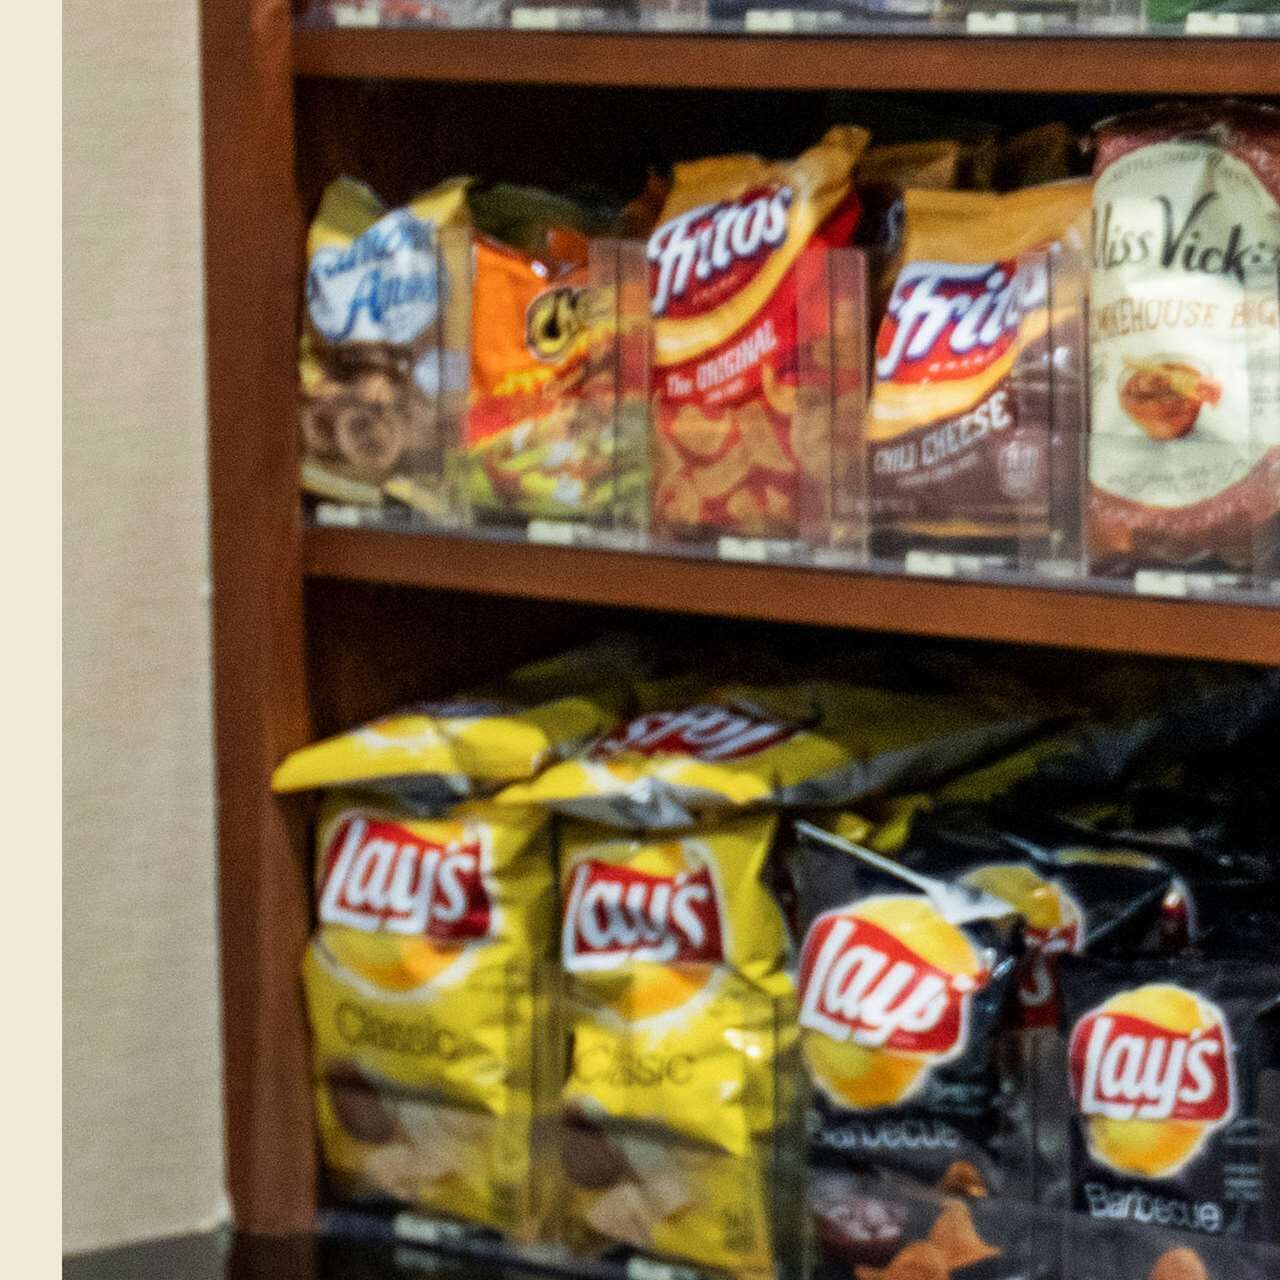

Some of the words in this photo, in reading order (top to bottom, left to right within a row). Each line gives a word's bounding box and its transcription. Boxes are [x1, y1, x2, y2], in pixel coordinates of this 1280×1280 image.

[647, 187, 794, 316] Fritos
[695, 320, 778, 390] ORIGINAL
[920, 392, 1013, 466] CHEESE
[319, 817, 470, 936] Lay's
[562, 863, 708, 974] Lay's
[800, 920, 978, 1048] Lay's
[1080, 1015, 1220, 1119] Lay's
[1084, 1181, 1223, 1233] Barbecue
